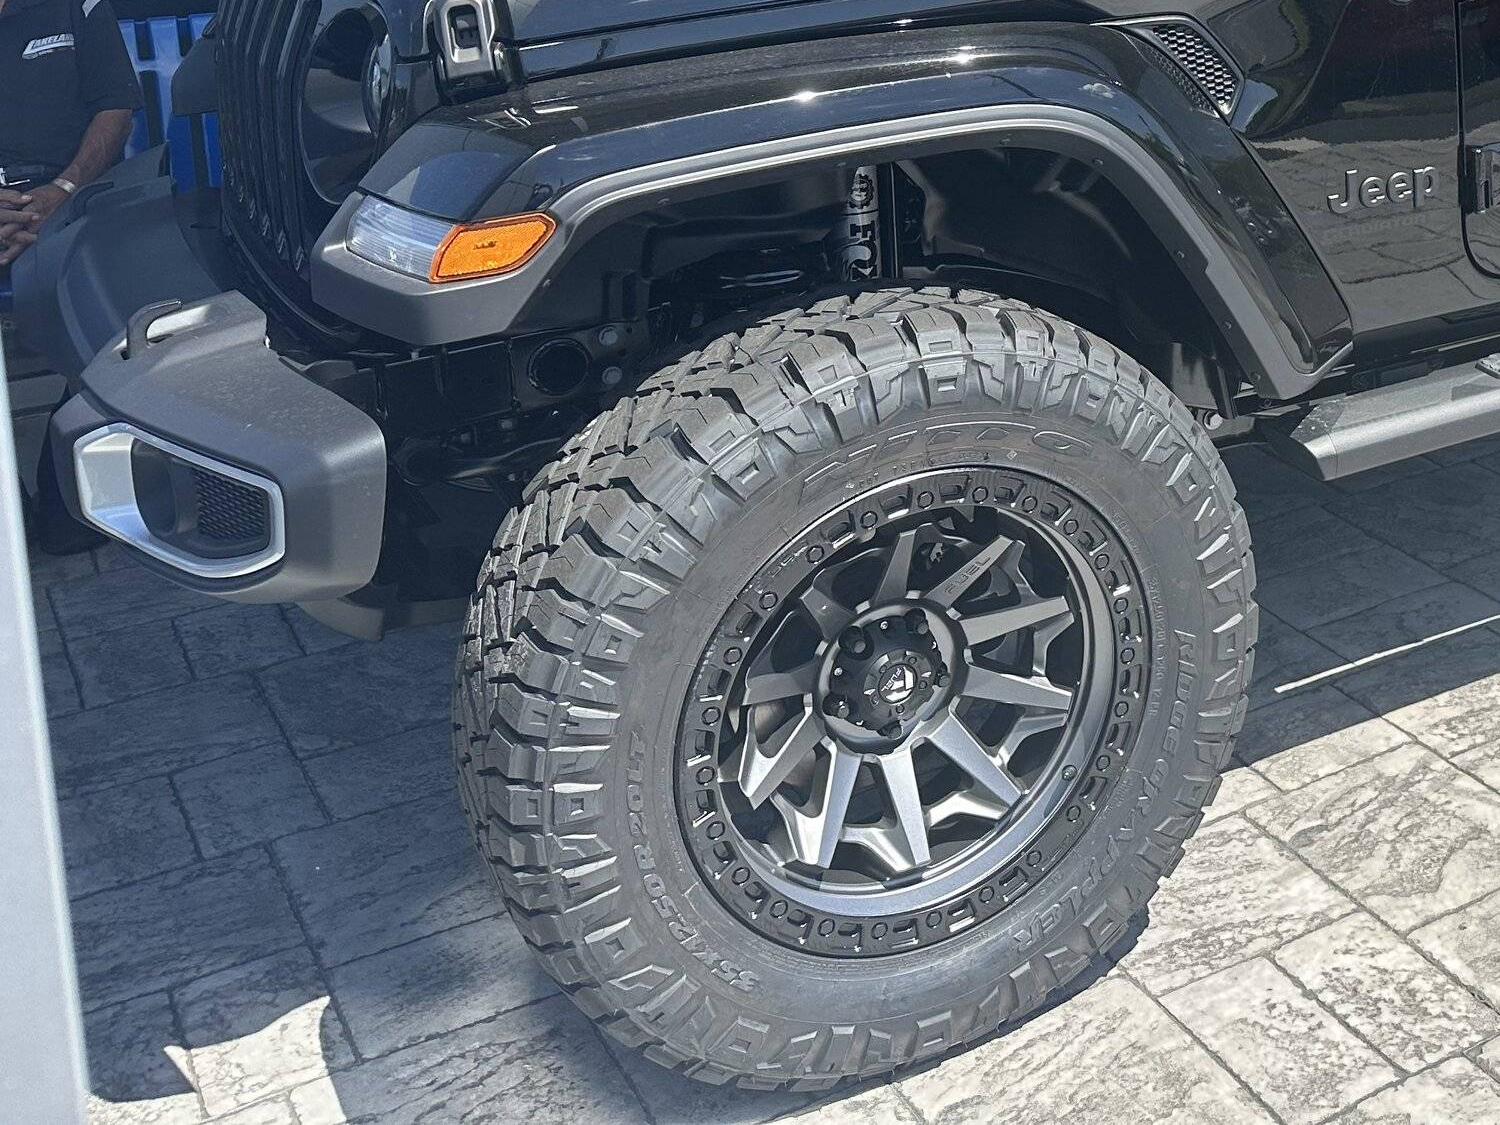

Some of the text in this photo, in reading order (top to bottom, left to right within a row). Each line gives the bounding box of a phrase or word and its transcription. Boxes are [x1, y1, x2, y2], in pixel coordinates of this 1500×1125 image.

[1327, 166, 1440, 215] Jeep
[944, 555, 991, 595] FUEL
[880, 667, 902, 693] FUEL
